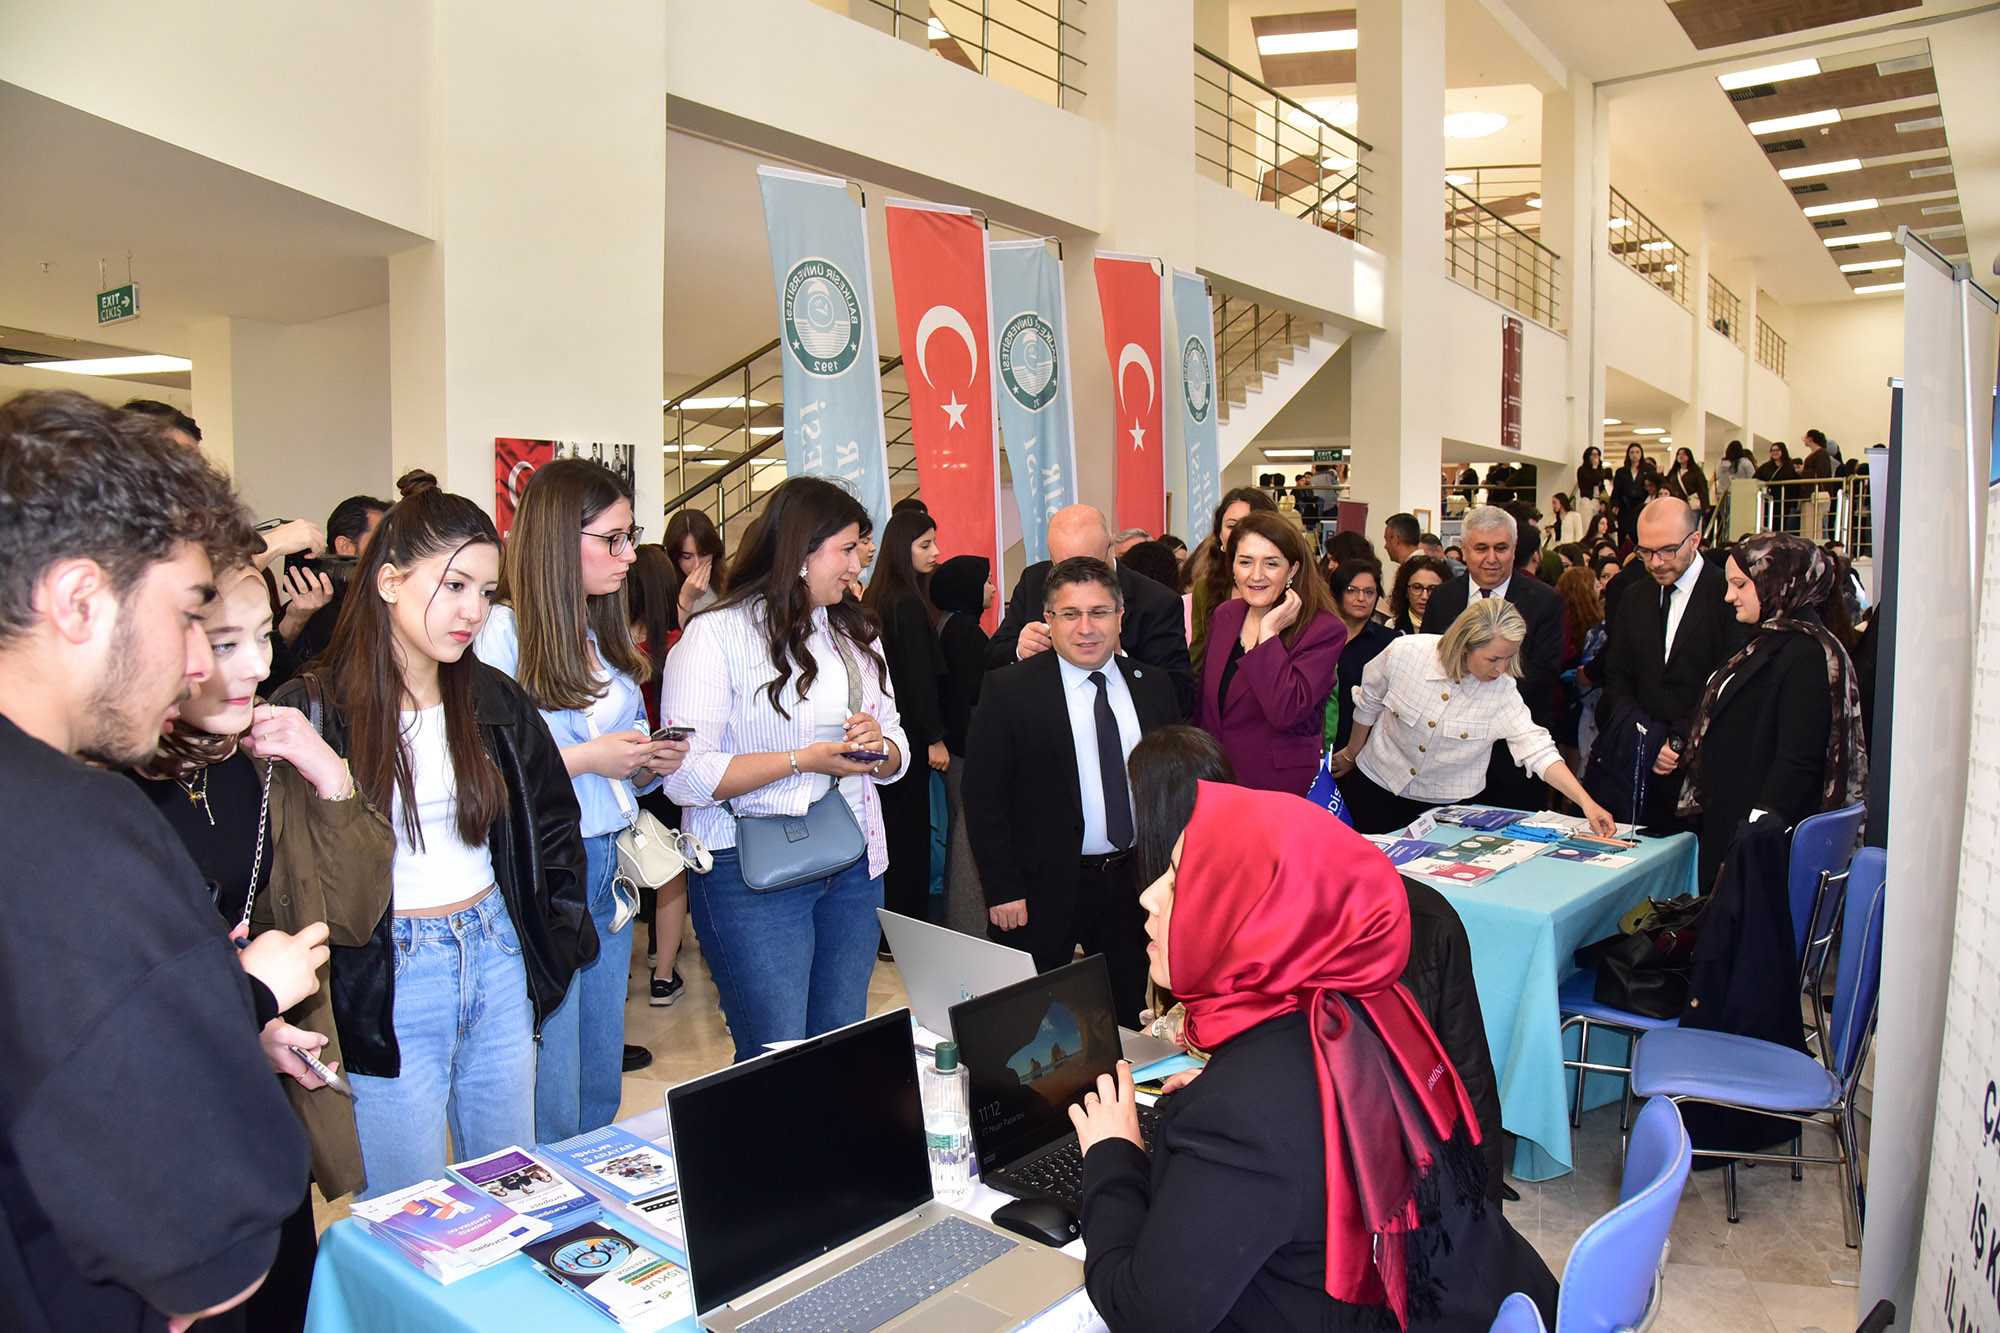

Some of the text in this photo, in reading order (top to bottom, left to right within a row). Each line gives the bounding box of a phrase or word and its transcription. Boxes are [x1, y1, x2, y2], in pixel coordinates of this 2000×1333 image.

[102, 292, 120, 309] EXIT
[978, 1100, 1001, 1122] 11:12
[532, 1203, 569, 1219] europas
[457, 1219, 493, 1236] EUROPASS
[469, 1236, 509, 1253] europass
